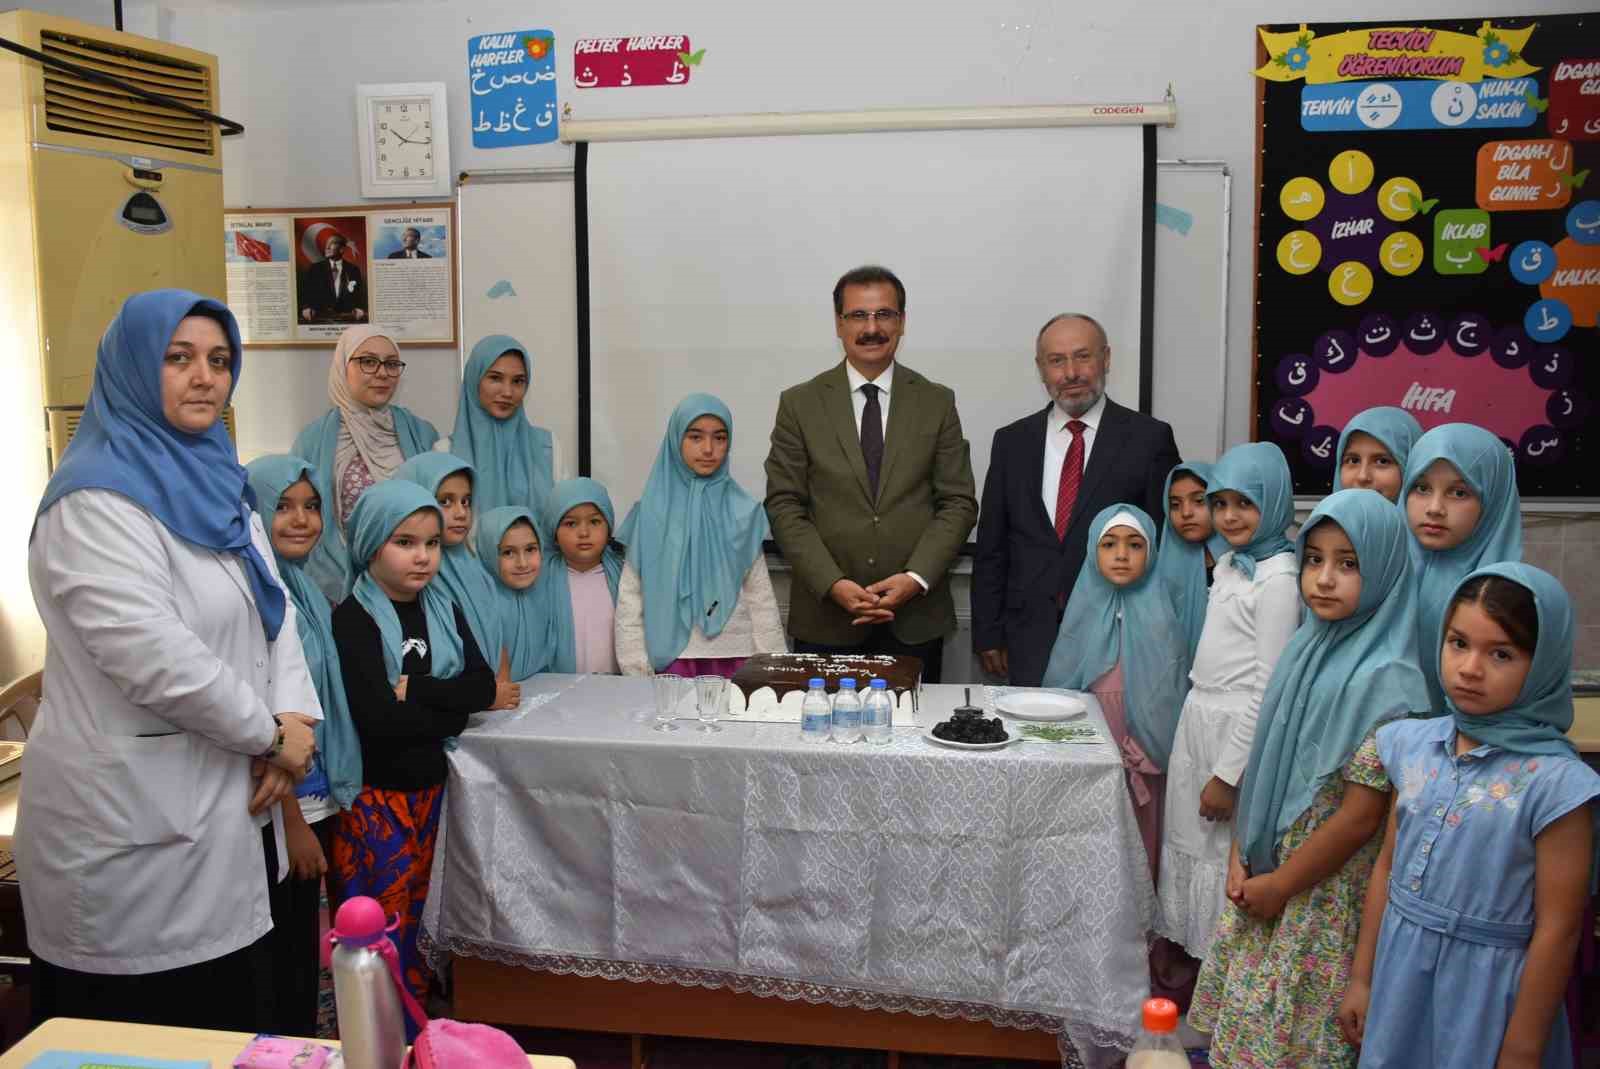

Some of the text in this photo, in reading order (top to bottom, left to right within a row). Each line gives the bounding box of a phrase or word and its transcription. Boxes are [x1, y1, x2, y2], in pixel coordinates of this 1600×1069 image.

[479, 34, 516, 50] KALIN
[575, 36, 685, 54] PELTEK HARFLER
[471, 50, 525, 68] HARFLER
[1093, 104, 1144, 114] CODEGEN
[1301, 97, 1355, 116] TENVİN
[1476, 102, 1525, 120] SAKİN
[1488, 185, 1542, 201] GUNNE
